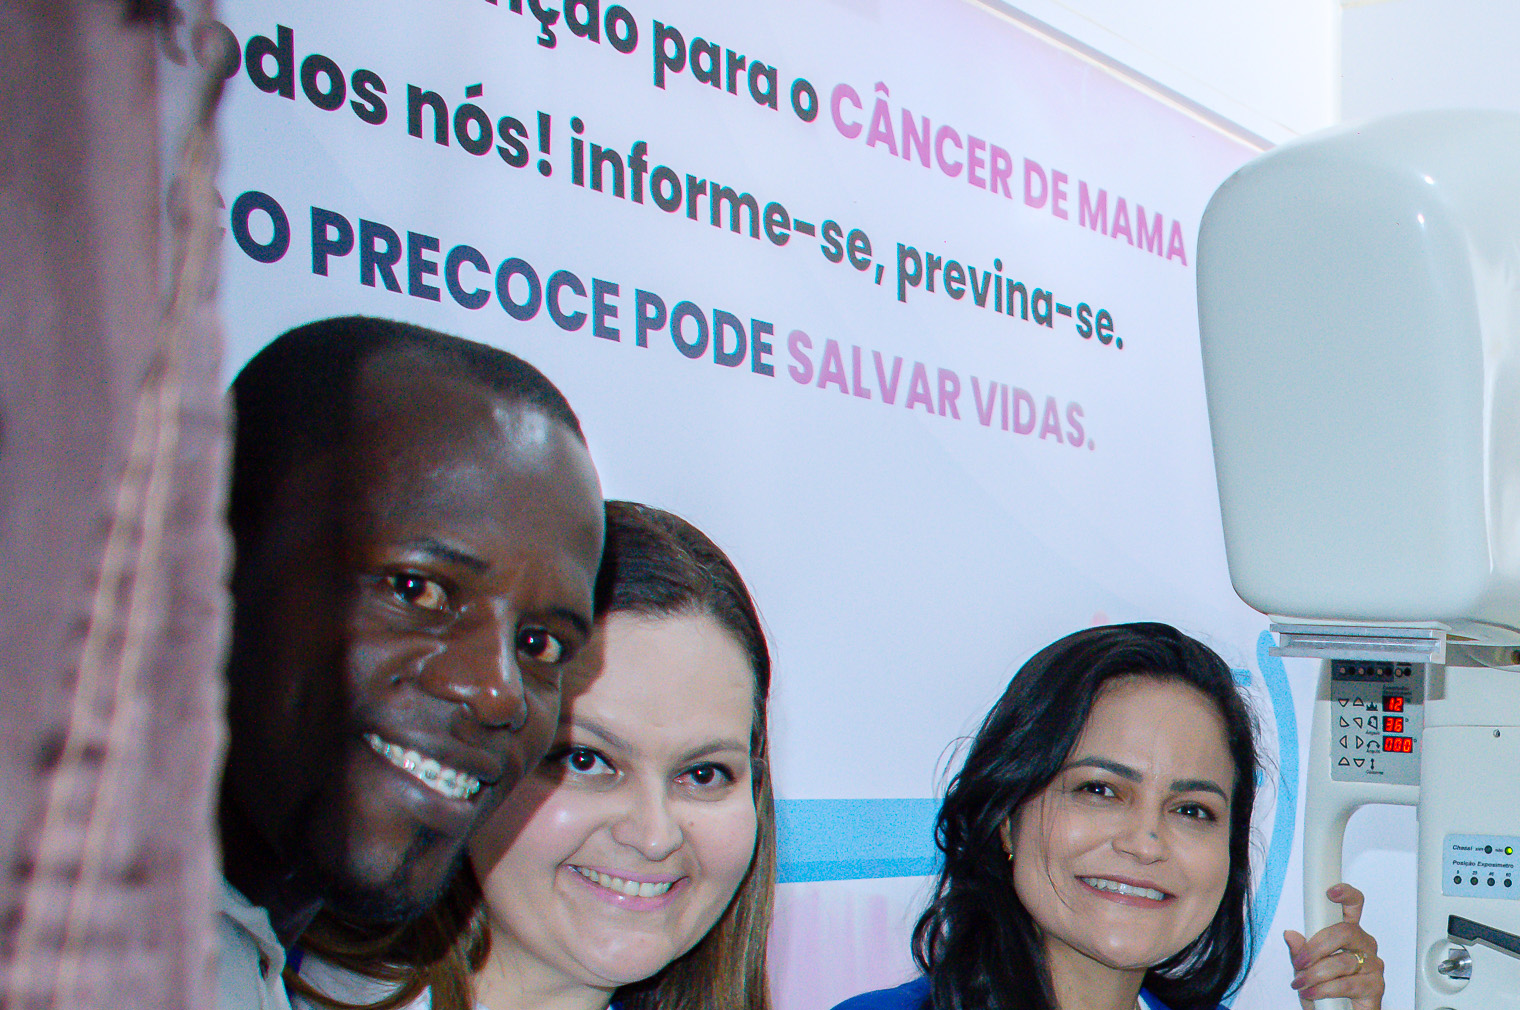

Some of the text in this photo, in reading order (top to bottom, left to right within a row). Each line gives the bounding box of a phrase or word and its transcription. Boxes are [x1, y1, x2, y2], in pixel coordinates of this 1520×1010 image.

[652, 20, 778, 111] para
[791, 78, 819, 122] o
[830, 81, 1013, 199] CÂNCER
[1024, 158, 1069, 219] DE
[1078, 181, 1188, 266] MAMA
[406, 83, 552, 177] nós!
[571, 116, 884, 285] informe-se,
[897, 242, 1124, 350] previna-se.
[310, 205, 621, 343] PRECOCE
[635, 288, 776, 378] PODE
[787, 329, 961, 420] SALVAR
[970, 375, 1096, 452] VIDAS.
[1384, 737, 1412, 753] 000
[1385, 716, 1403, 732] 36
[1388, 696, 1403, 712] 12
